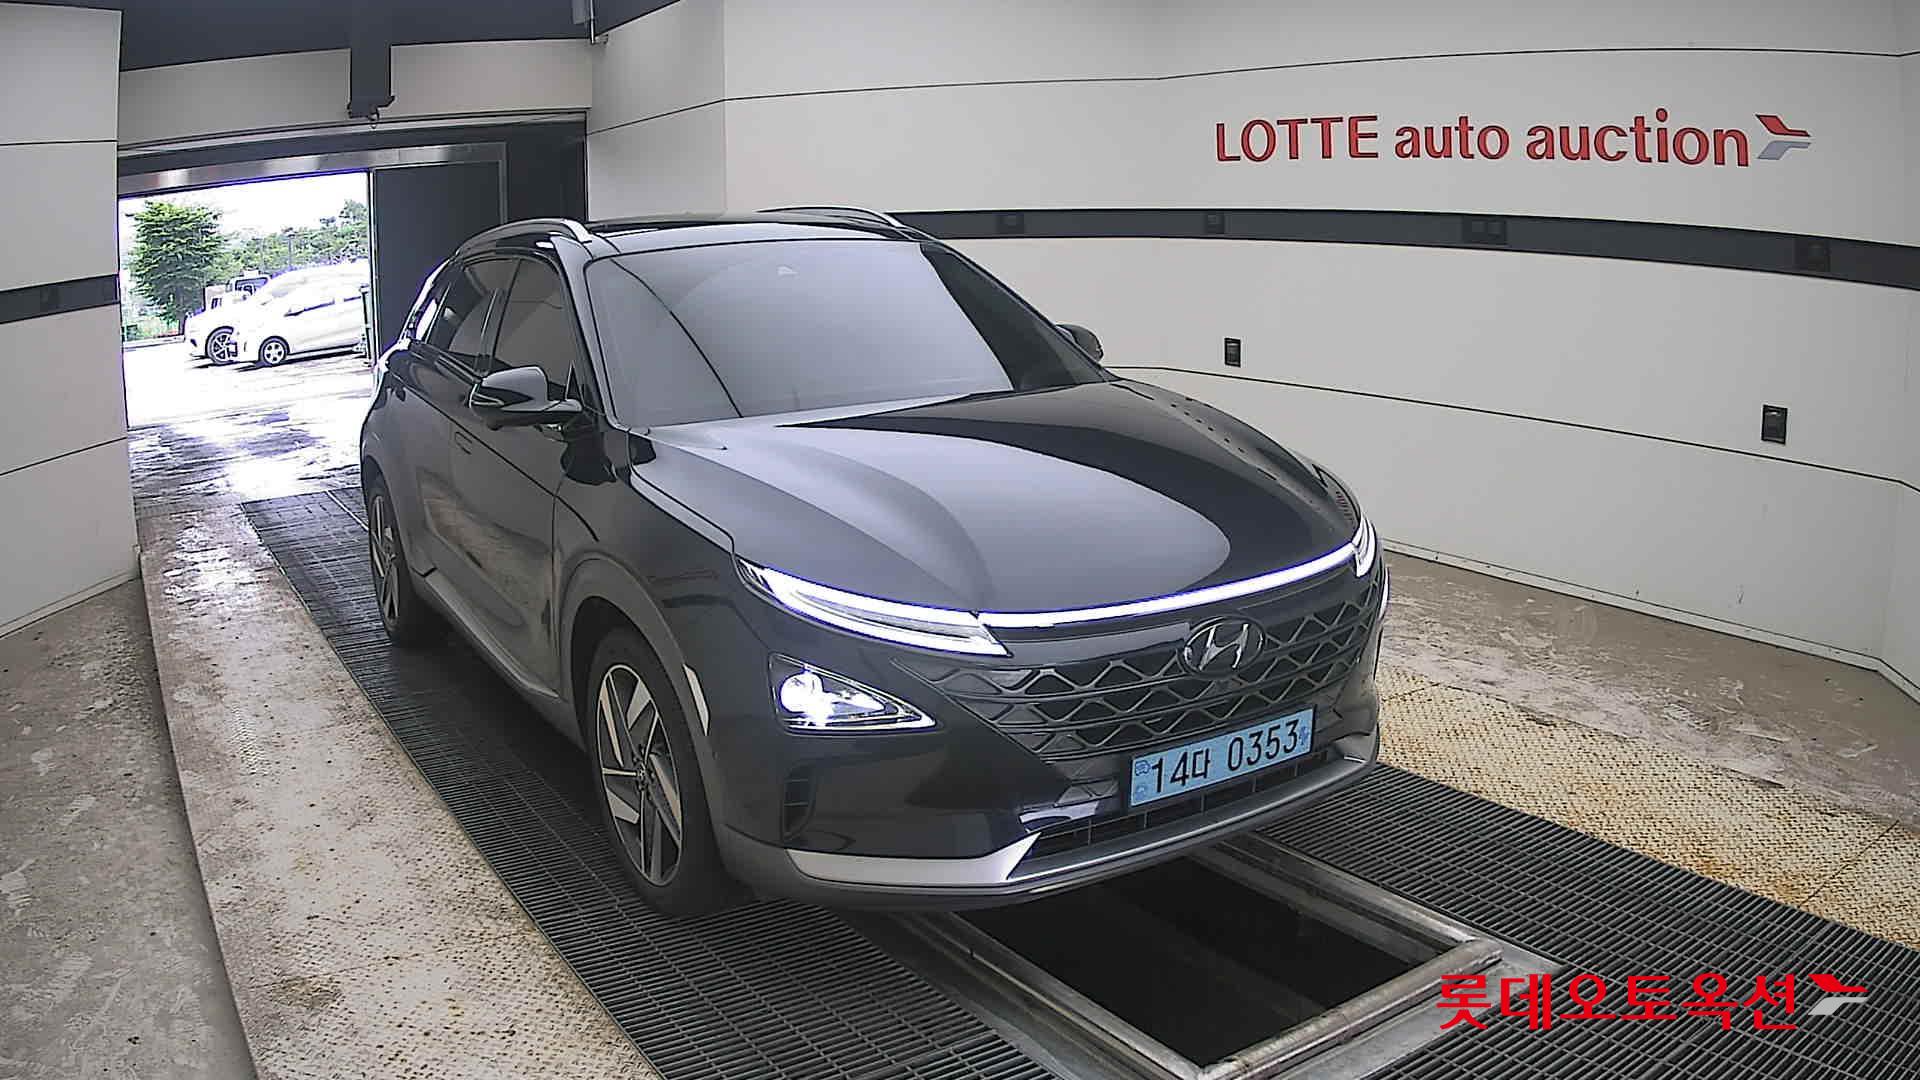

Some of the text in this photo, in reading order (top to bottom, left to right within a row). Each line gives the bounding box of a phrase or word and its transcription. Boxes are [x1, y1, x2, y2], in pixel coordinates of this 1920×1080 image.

[1216, 107, 1749, 167] LOTTE auto auction
[1227, 719, 1299, 771] 0353
